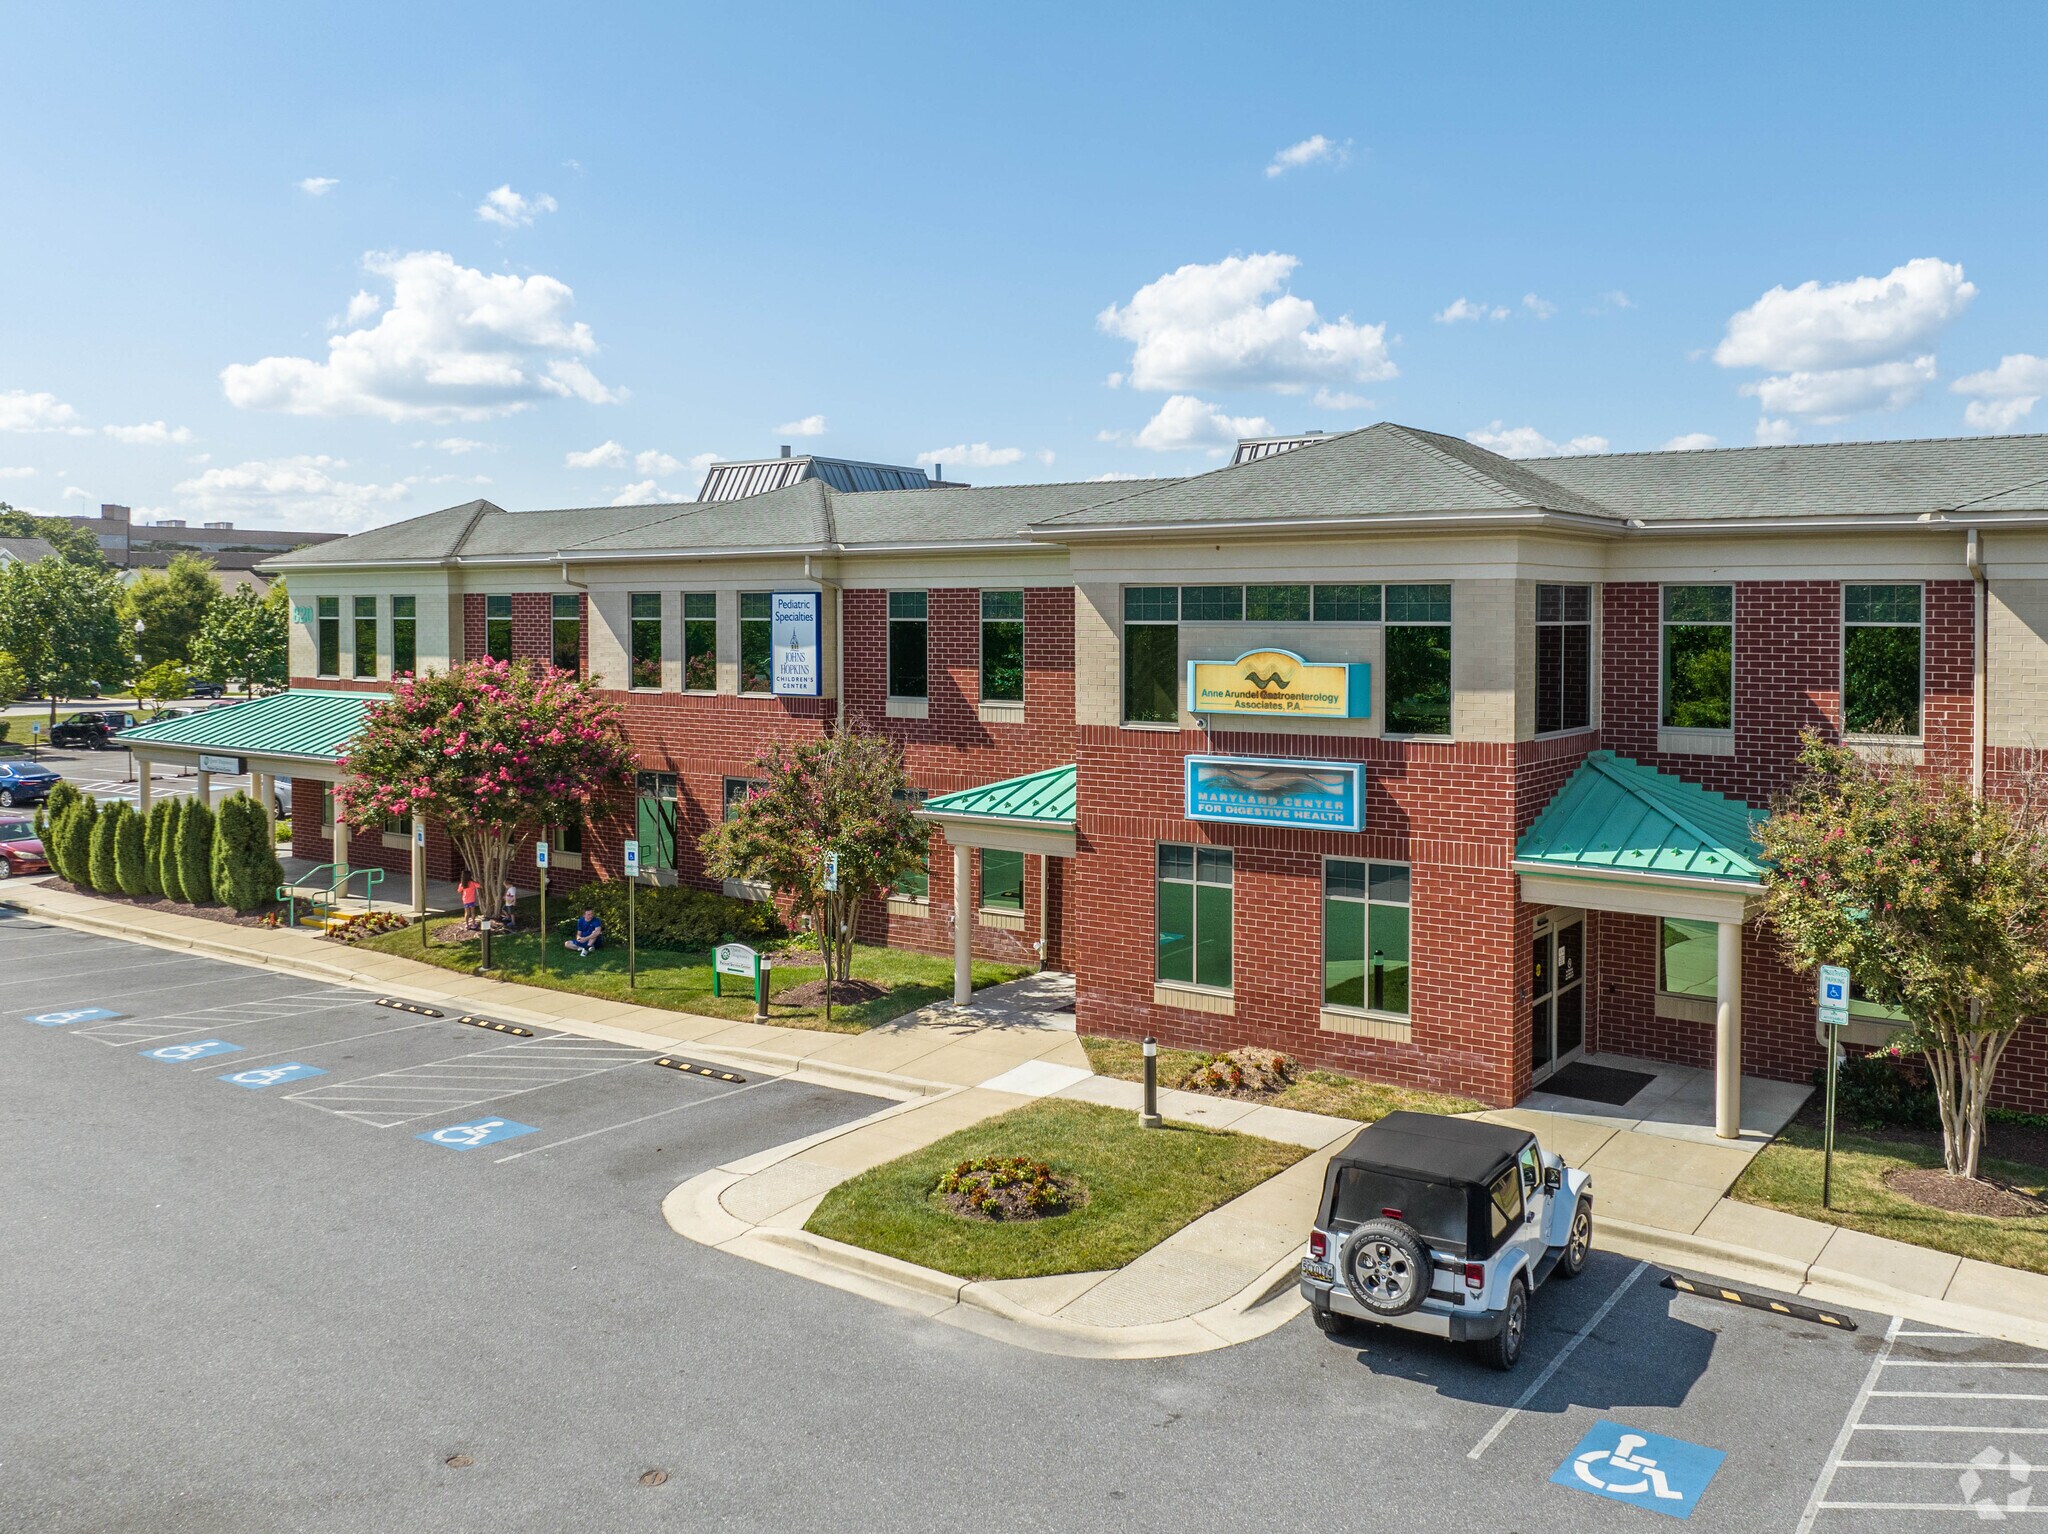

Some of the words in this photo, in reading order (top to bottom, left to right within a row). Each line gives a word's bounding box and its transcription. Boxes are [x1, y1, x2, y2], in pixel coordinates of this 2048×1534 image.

[778, 599, 810, 609] Pediatric
[775, 611, 814, 624] Specialties
[785, 652, 805, 664] JOHNS
[780, 664, 810, 675] HOPKINS
[1201, 688, 1224, 698] Anne
[1225, 689, 1259, 699] Arundel
[1260, 690, 1339, 704] Gastroenterology
[1234, 700, 1285, 711] Associates,
[1286, 702, 1304, 711] P.A.
[1197, 792, 1278, 805] MARYLAND
[1283, 797, 1344, 810] CENTER
[1198, 804, 1222, 813] FOR
[1226, 806, 1290, 818] DIGESTIVE
[1294, 810, 1344, 822] HEALTH
